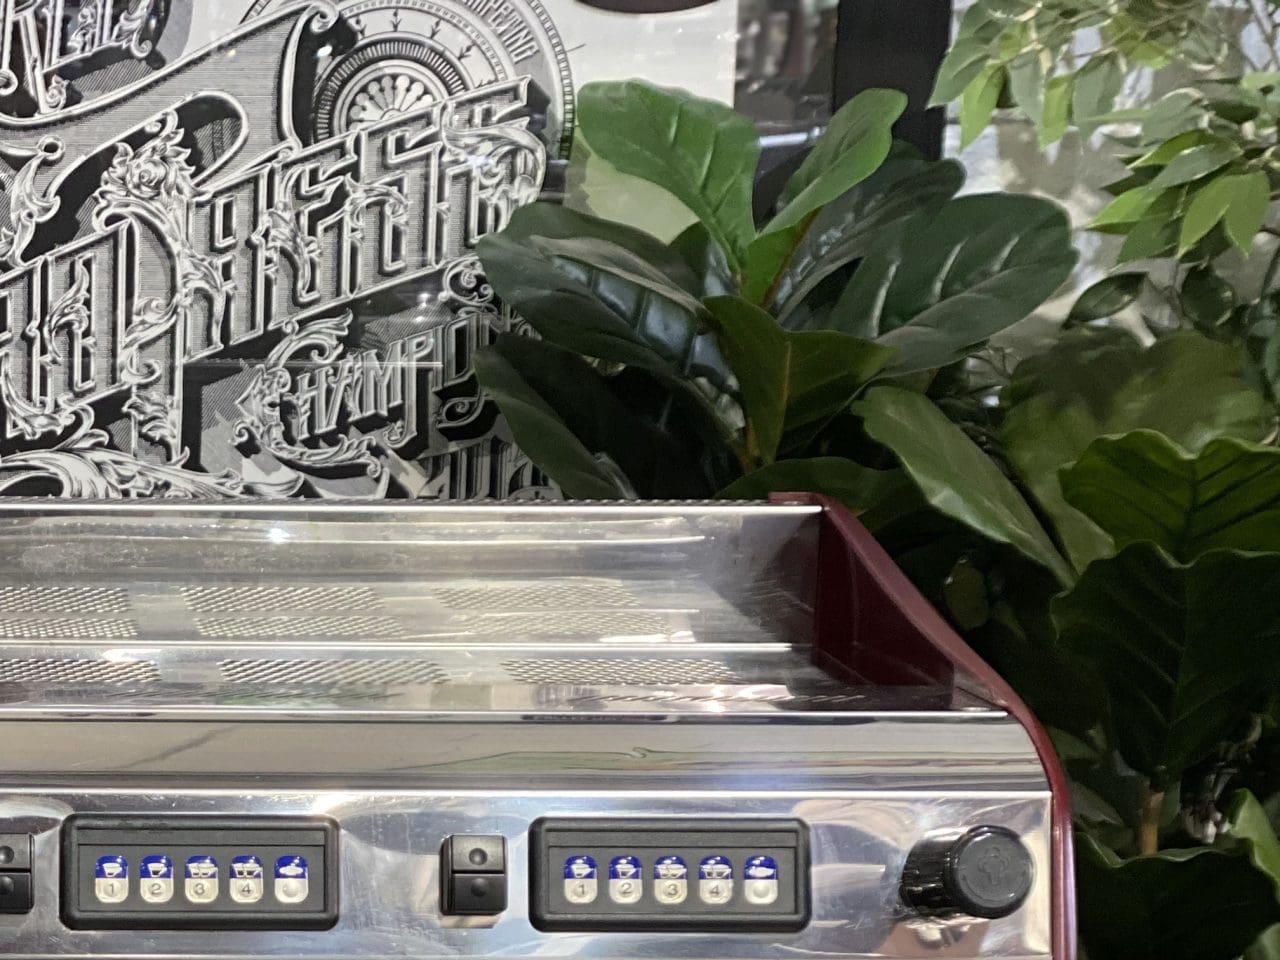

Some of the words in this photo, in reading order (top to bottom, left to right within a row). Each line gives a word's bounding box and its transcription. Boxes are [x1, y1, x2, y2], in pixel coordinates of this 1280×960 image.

[109, 883, 116, 894] 1
[151, 883, 162, 894] 2
[195, 883, 205, 894] 3
[241, 883, 251, 894] 4
[579, 884, 586, 895] 1
[621, 883, 632, 895] 2
[667, 884, 678, 896] 3
[709, 884, 720, 896] 4
